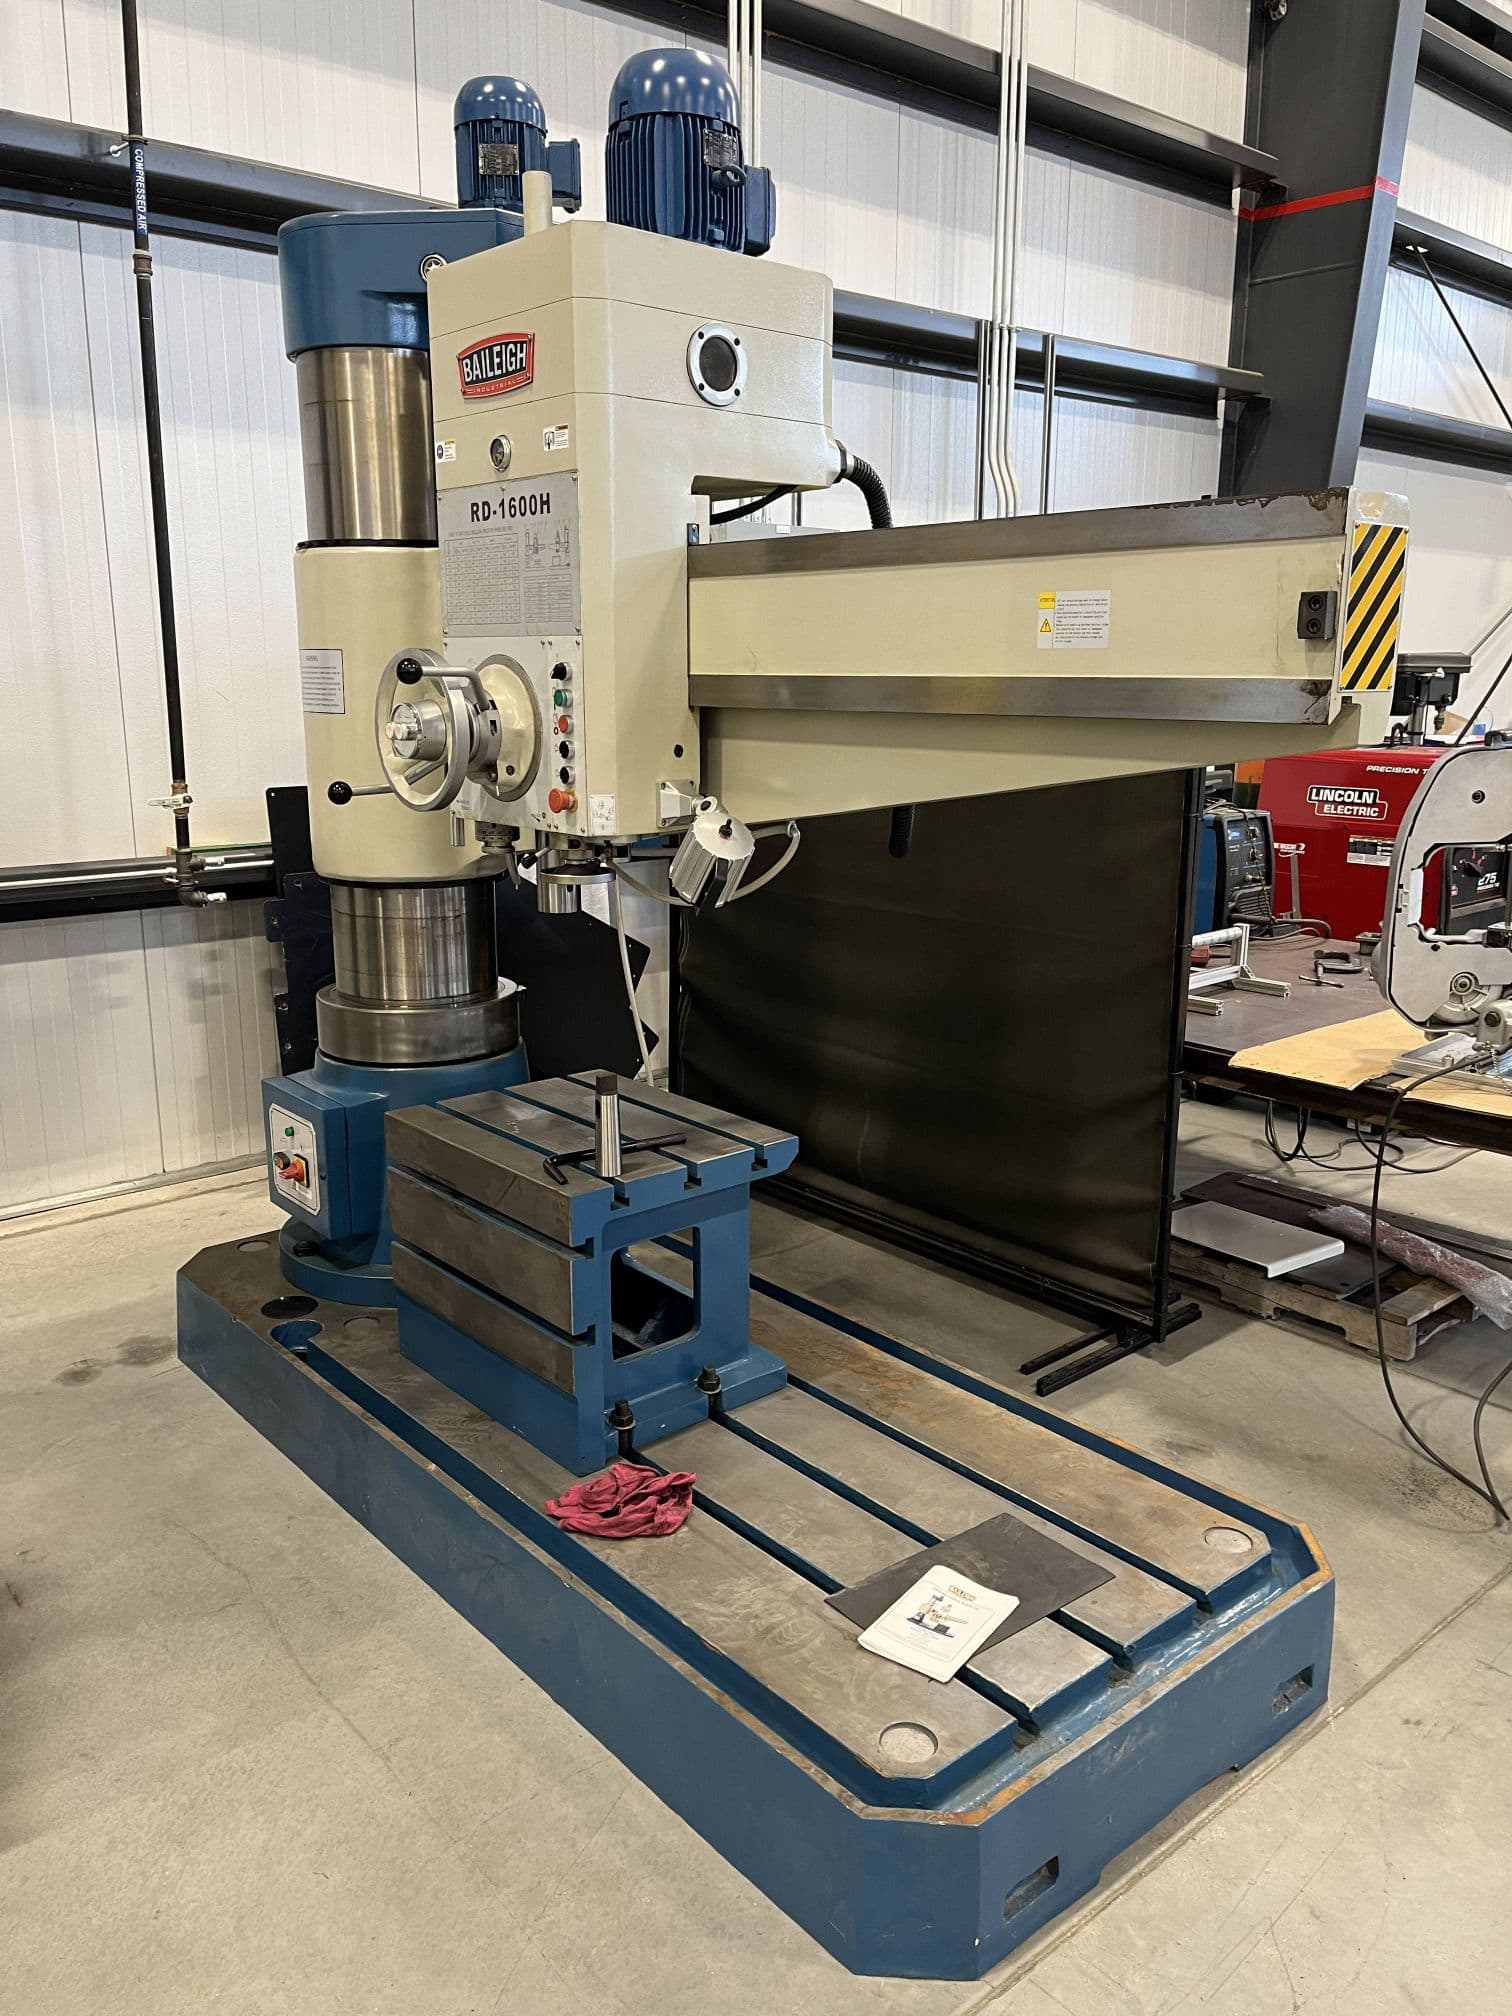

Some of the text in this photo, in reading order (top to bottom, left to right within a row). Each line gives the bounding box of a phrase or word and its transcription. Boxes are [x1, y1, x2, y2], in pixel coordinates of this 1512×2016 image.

[134, 148, 148, 233] COMPRESSED AIR
[462, 343, 527, 382] BAILEIGH
[473, 379, 516, 393] INDUSTRIAL
[470, 492, 551, 523] RD-1600H
[1366, 765, 1419, 775] PRECISION
[1310, 788, 1374, 804] LINCOLN
[1323, 804, 1379, 817] ELECTRIC
[1477, 872, 1498, 886] 275
